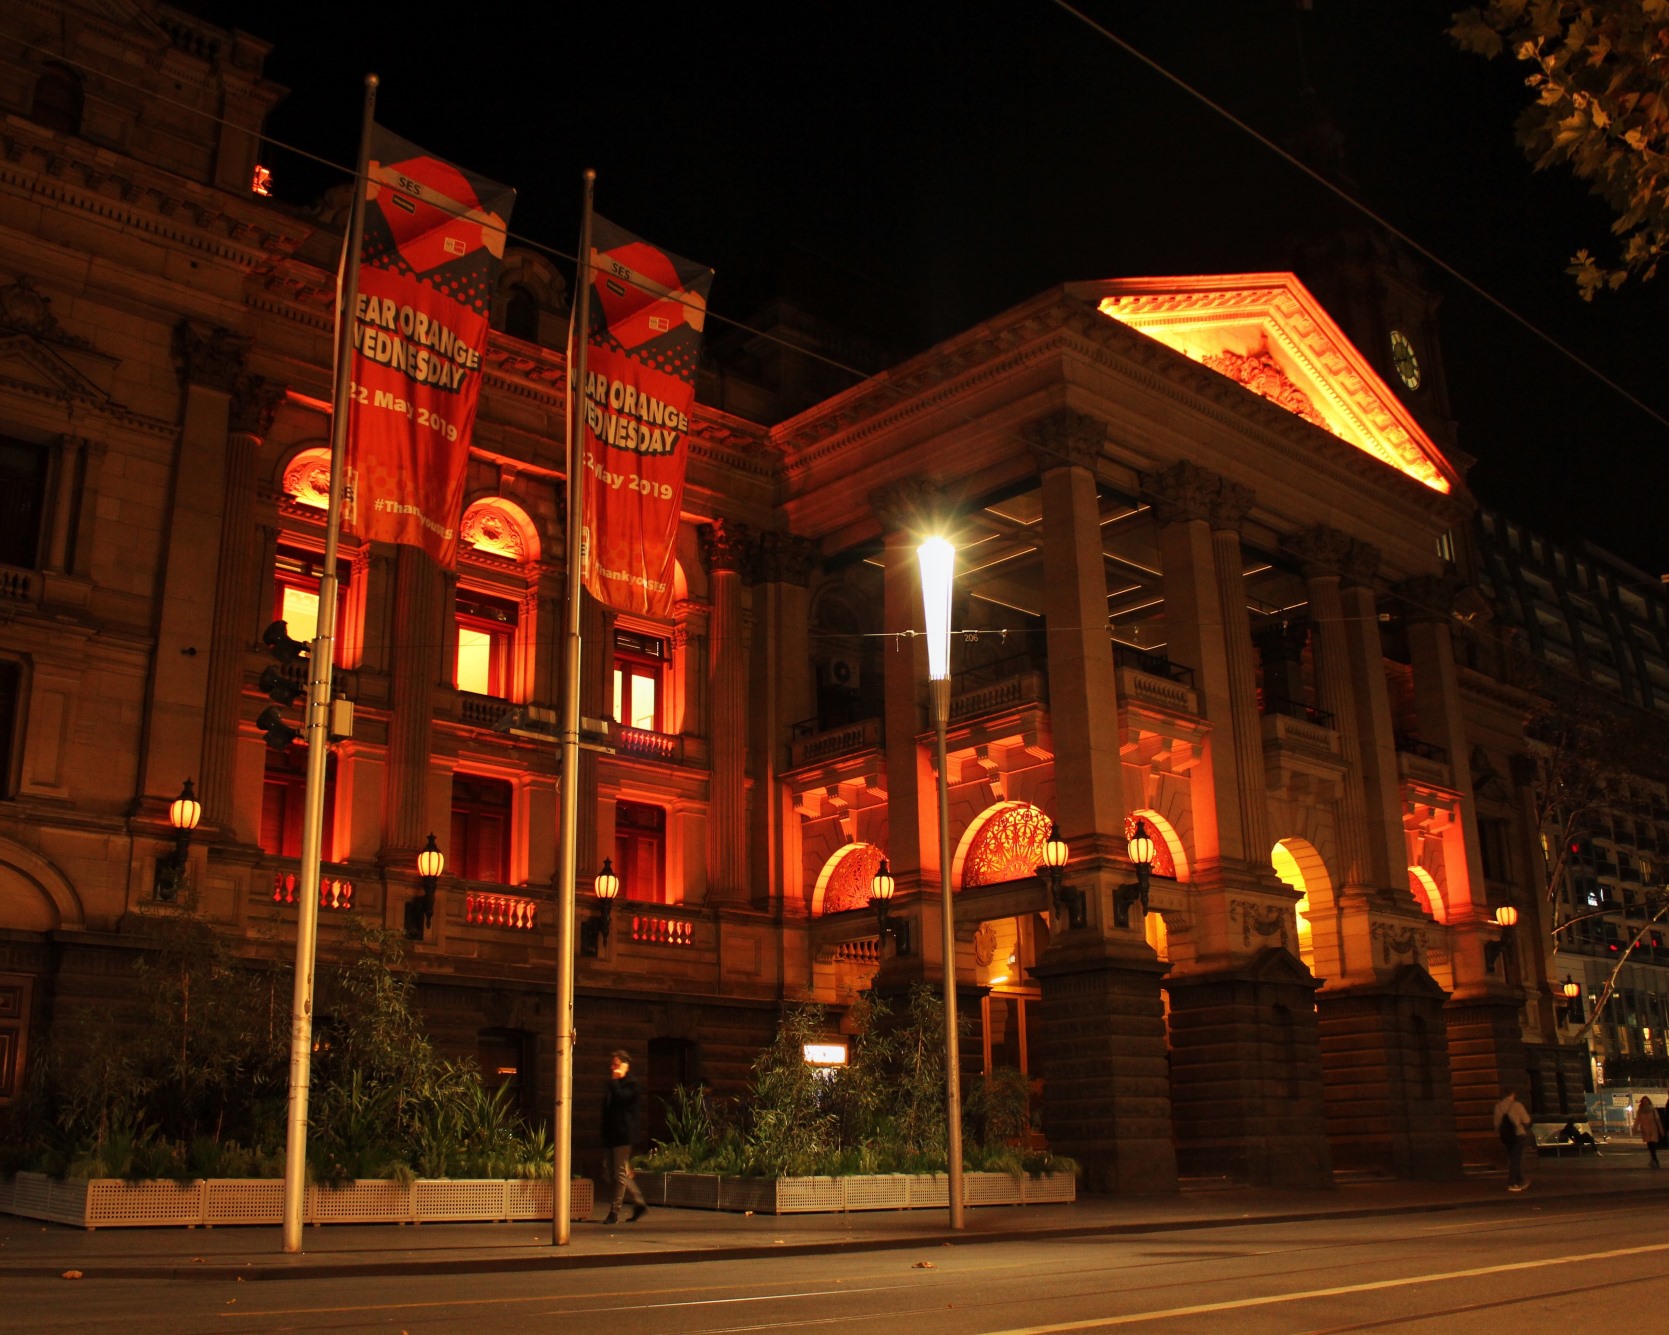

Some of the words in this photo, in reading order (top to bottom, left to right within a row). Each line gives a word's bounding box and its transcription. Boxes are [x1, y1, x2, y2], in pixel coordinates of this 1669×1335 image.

[399, 177, 421, 195] SES
[612, 263, 631, 280] SES
[355, 293, 396, 330] EAR
[400, 304, 479, 368] ORANGE
[374, 390, 413, 419] May
[417, 407, 458, 441] 2019
[584, 398, 677, 452] EDNESDAY
[610, 380, 688, 431] ORANGE
[629, 473, 673, 500] 2019
